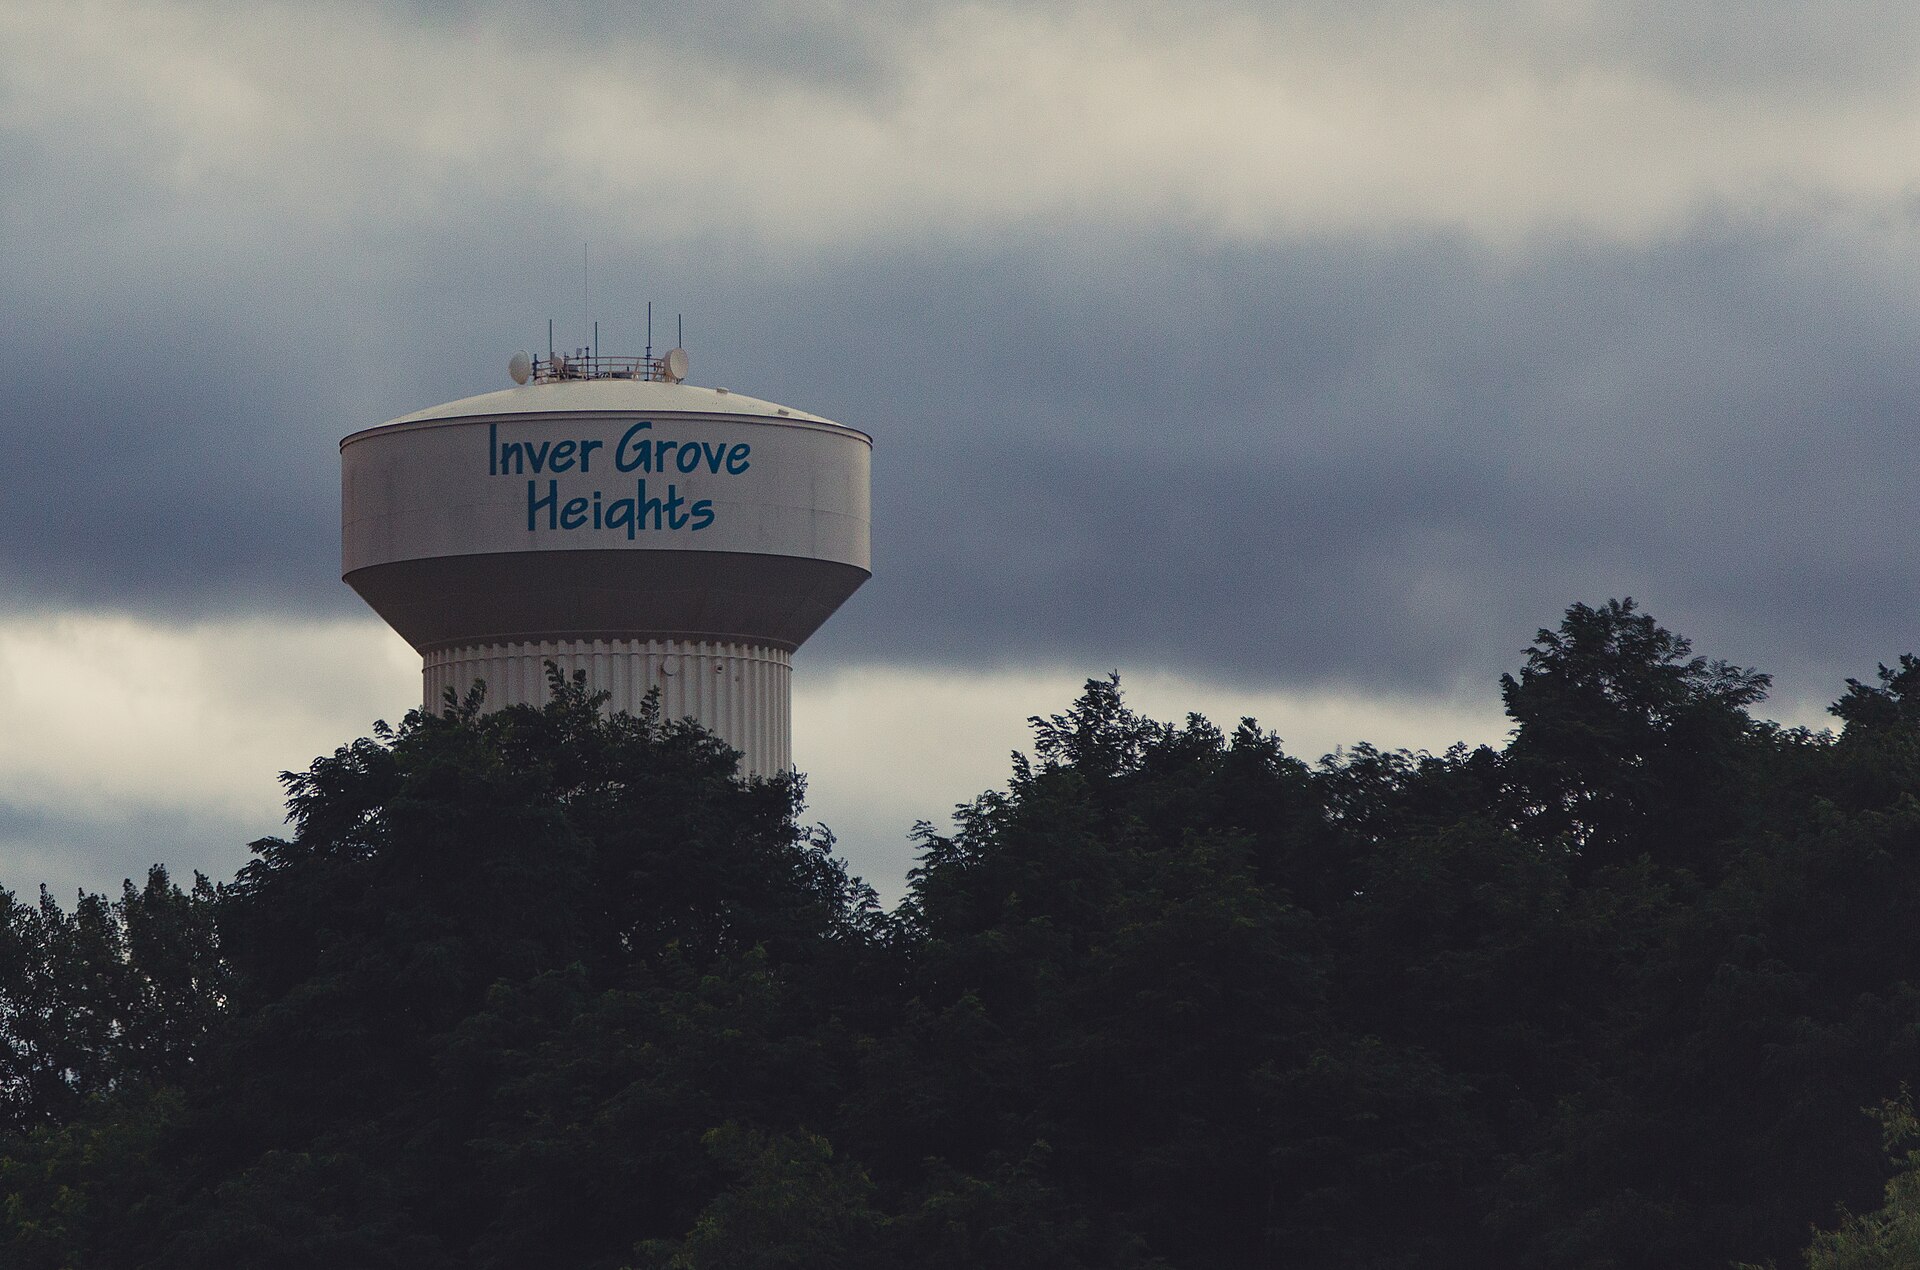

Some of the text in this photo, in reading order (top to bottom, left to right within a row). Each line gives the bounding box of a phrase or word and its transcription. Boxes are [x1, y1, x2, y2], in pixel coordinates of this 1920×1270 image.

[490, 421, 751, 475] Inver Grove
[528, 479, 715, 540] Heights
